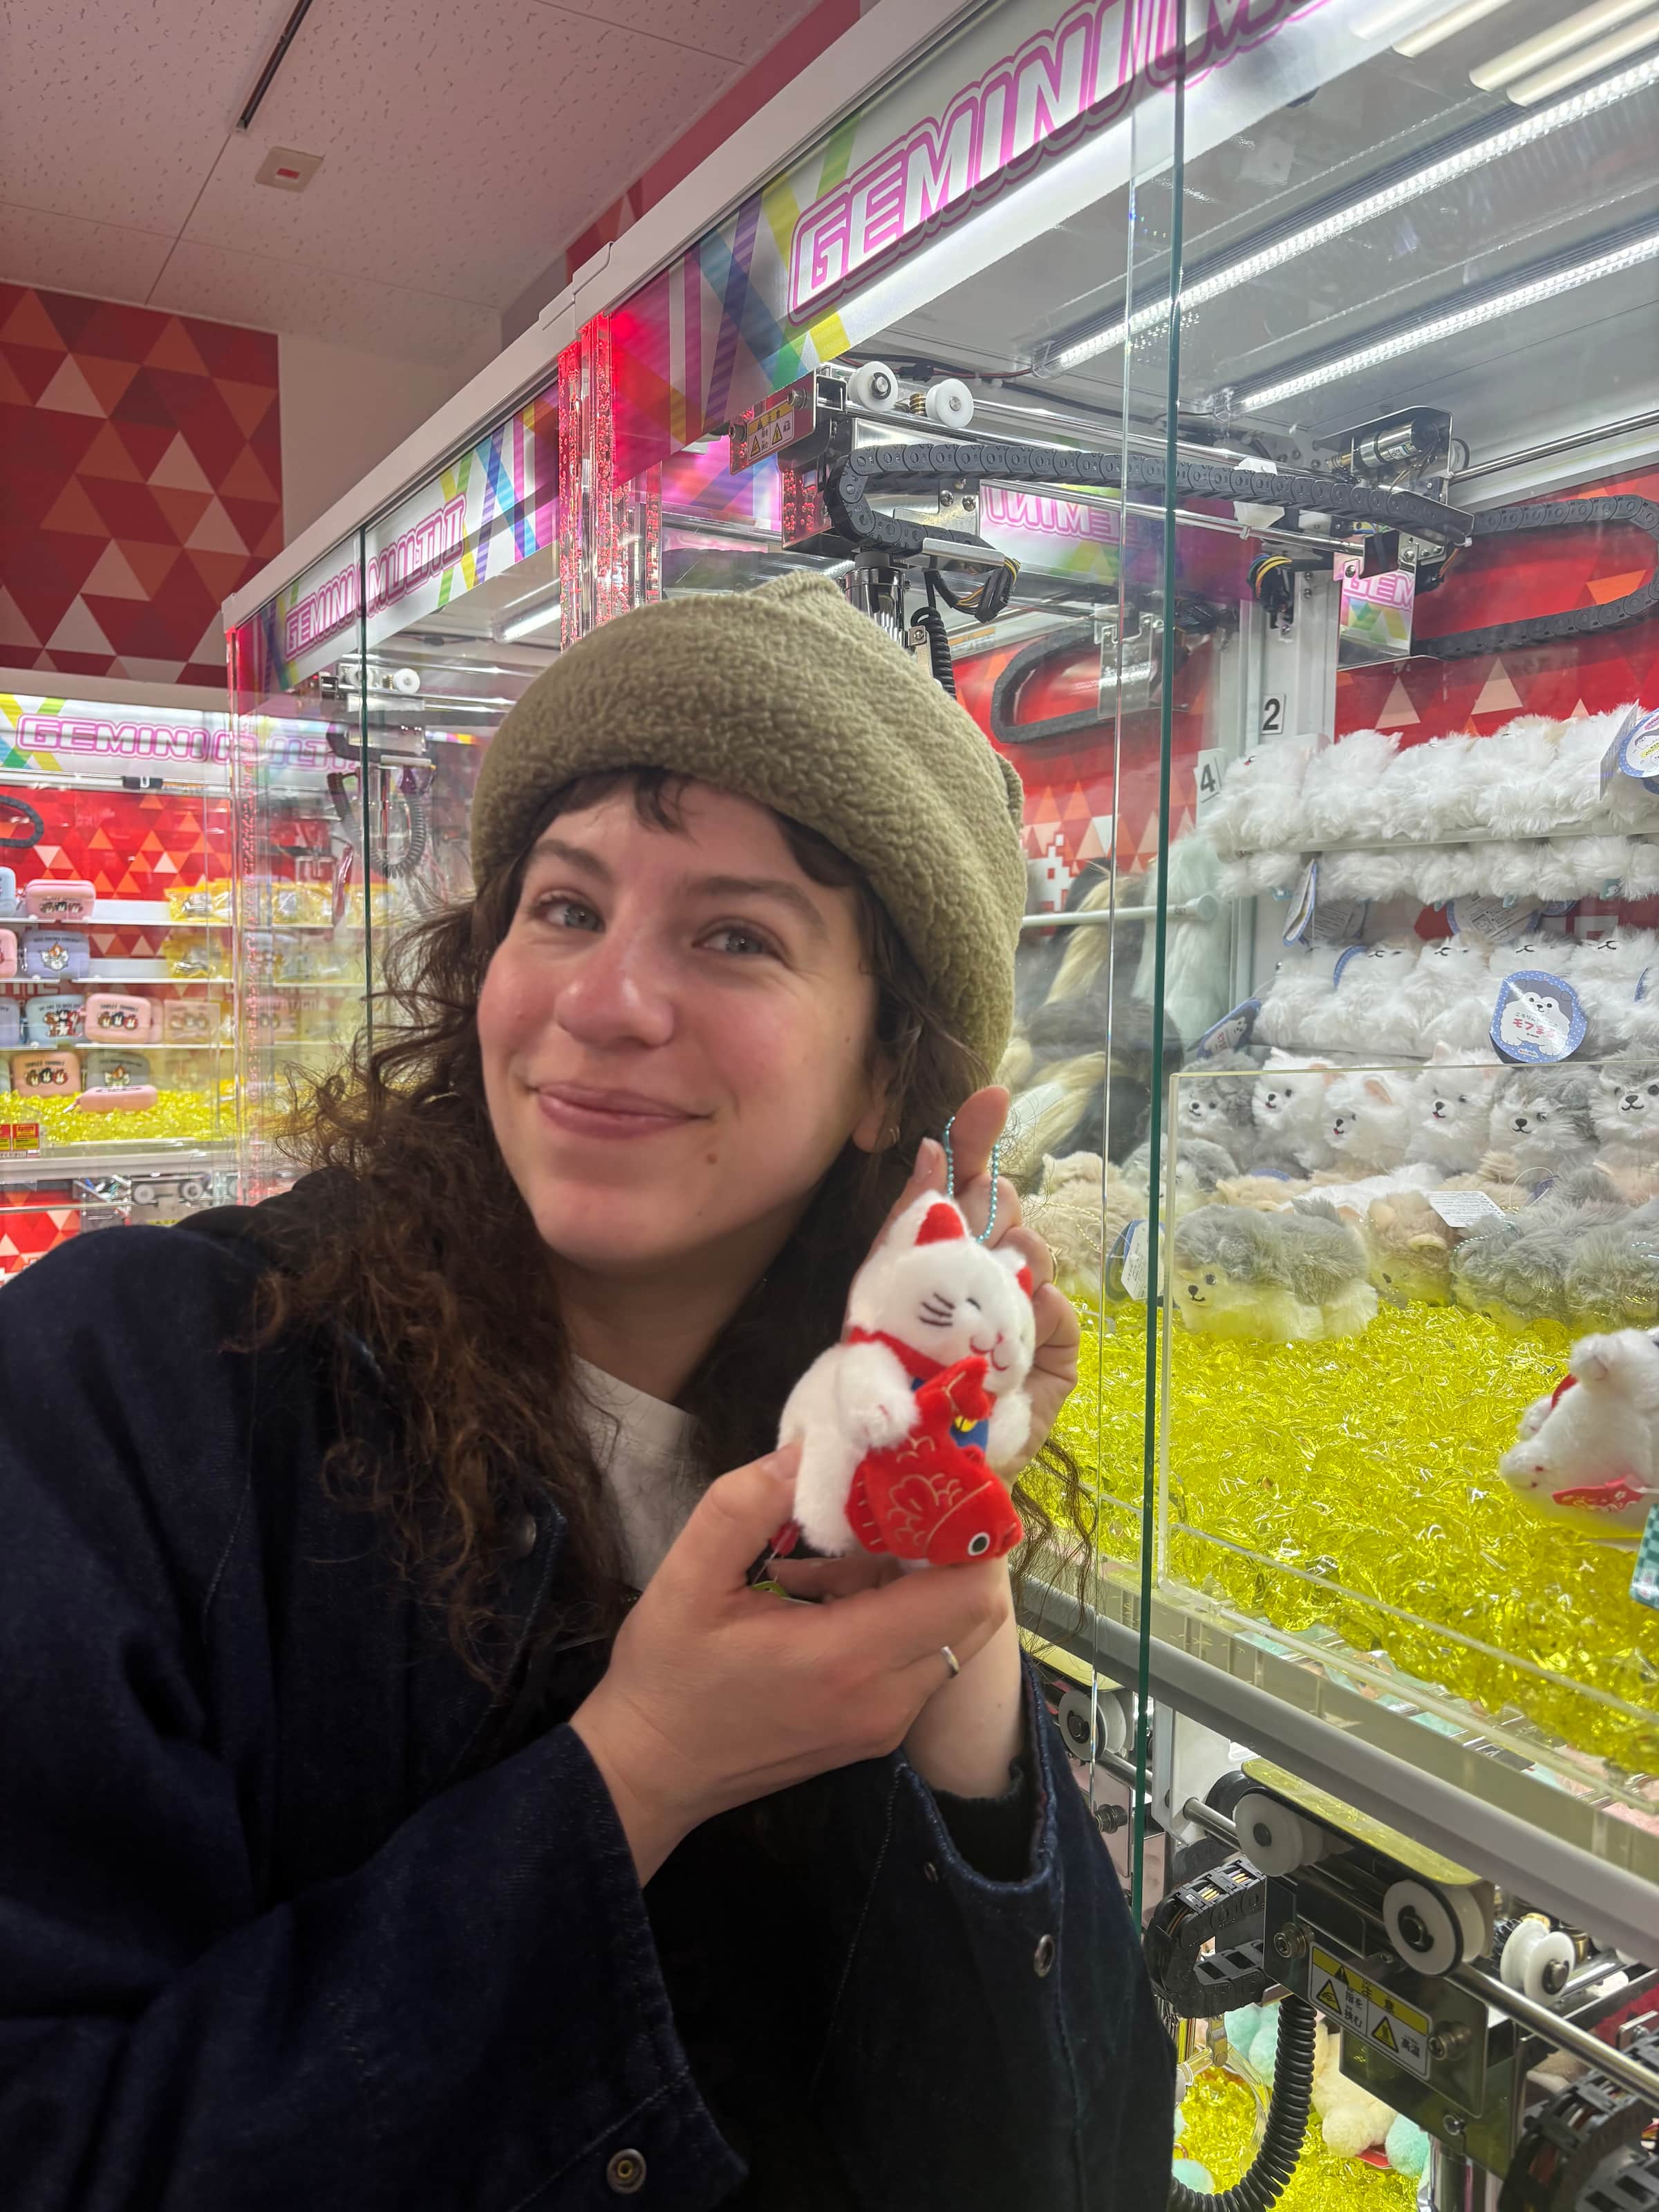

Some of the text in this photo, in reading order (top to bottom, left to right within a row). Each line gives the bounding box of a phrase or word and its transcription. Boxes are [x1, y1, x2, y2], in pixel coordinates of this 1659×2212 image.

[791, 0, 1133, 318] GEMINI
[285, 564, 356, 659] GEMINI
[367, 512, 442, 613] MULTI
[1262, 698, 1280, 731] 2
[19, 717, 206, 761] GEMINI
[1200, 764, 1216, 792] 4
